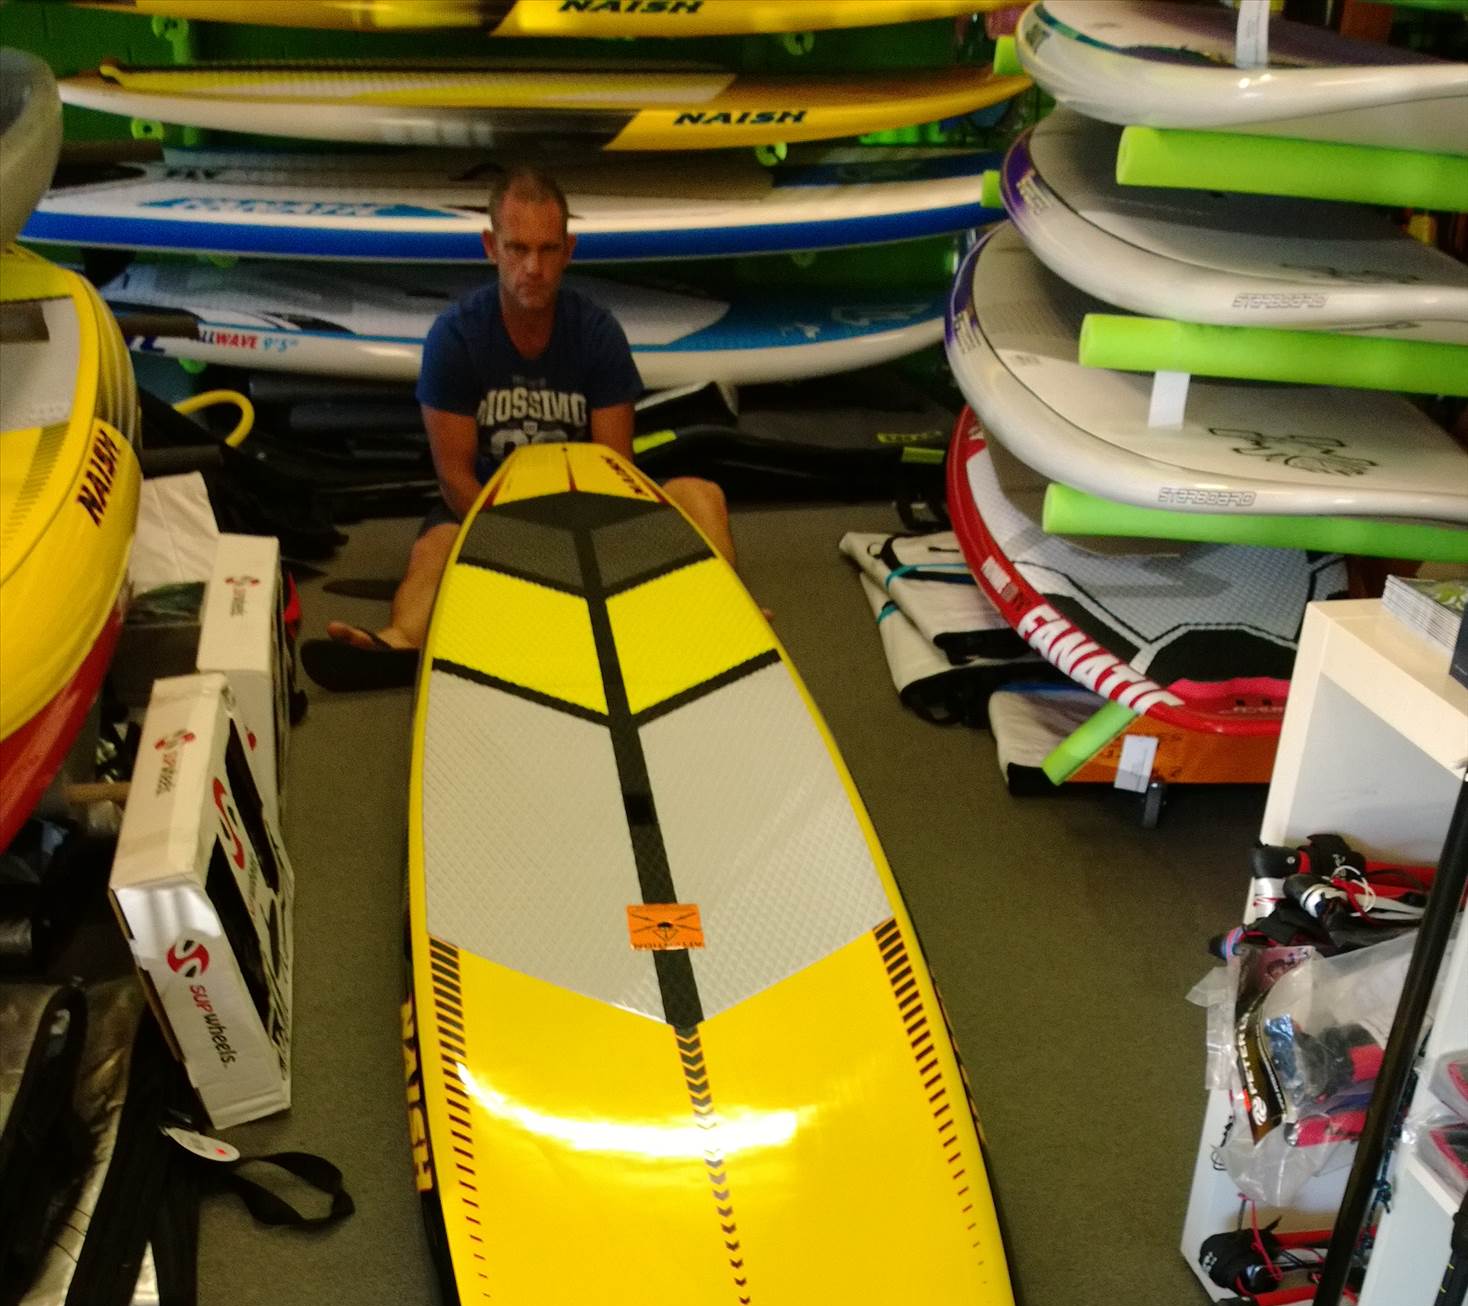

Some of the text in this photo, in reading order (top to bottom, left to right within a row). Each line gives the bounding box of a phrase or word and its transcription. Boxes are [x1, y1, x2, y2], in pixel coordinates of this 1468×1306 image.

[559, 0, 702, 13] NAISH
[673, 110, 808, 125] NAISH
[76, 428, 121, 527] NAISH
[1017, 602, 1187, 716] FANATIC
